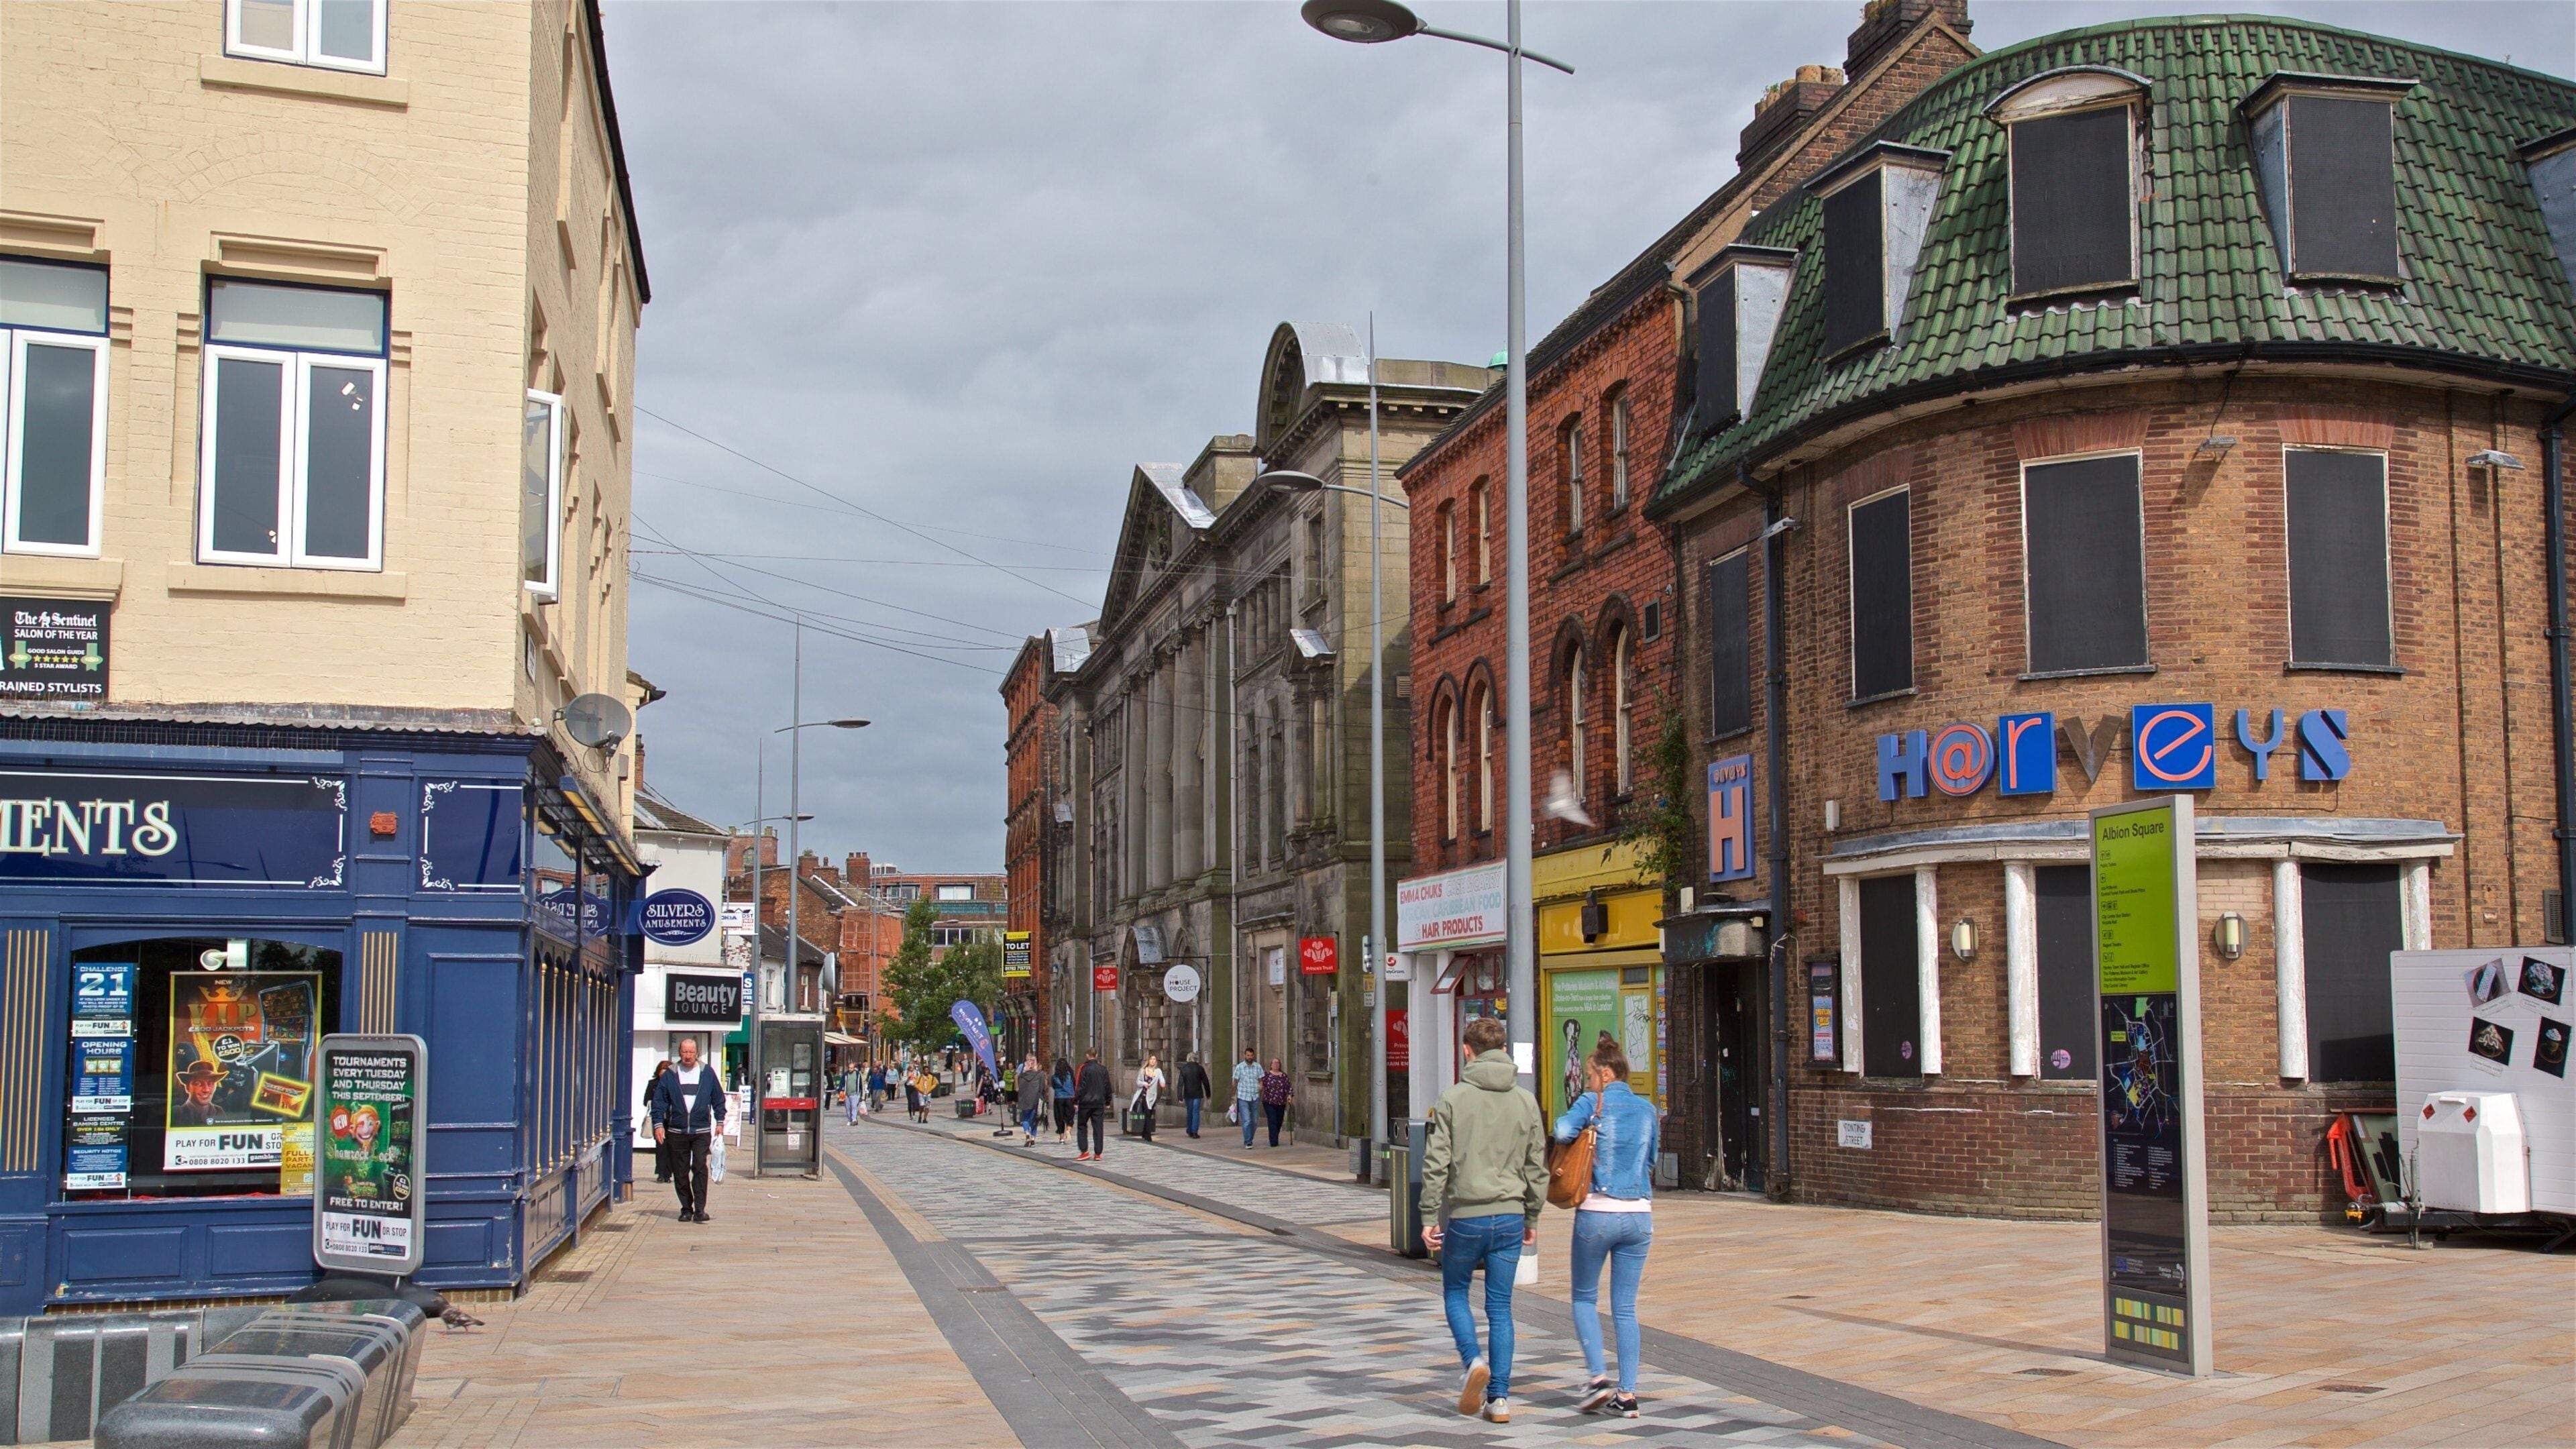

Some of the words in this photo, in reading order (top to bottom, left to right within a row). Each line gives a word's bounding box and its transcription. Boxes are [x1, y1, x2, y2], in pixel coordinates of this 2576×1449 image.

[15, 611, 38, 625] The
[52, 612, 97, 627] Sentinel
[15, 629, 43, 638] SALON
[45, 630, 56, 639] OF
[58, 631, 74, 639] THE
[76, 631, 98, 640] YEAR
[48, 683, 102, 693] STYLISTS
[1711, 786, 1745, 873] H
[2102, 825, 2129, 841] Albion
[2132, 822, 2164, 839] Square
[1400, 888, 1419, 904] EMMA
[1421, 883, 1442, 900] CHUKS
[647, 904, 705, 918] SILVERS
[1432, 897, 1475, 918] CARIBBEAN
[1477, 892, 1502, 911] FOOD
[645, 920, 706, 928] AMUSEMENTS
[1421, 922, 1440, 938] HAIR
[1442, 915, 1483, 936] PRODUCTS
[1016, 942, 1030, 950] LET
[79, 973, 127, 996] 21
[675, 981, 737, 1007] Beauty
[188, 1004, 258, 1024] VIP
[675, 1003, 727, 1014] LOUNGE
[218, 1049, 241, 1057] £500
[333, 1056, 407, 1067] TOURNAMENTS
[333, 1068, 363, 1077] EVERY
[365, 1069, 406, 1079] TUESDAY
[333, 1079, 353, 1089] AND
[354, 1079, 406, 1091] THURSDAY
[331, 1091, 351, 1099] THIS
[352, 1092, 405, 1102] SEPTEMBER!
[333, 1114, 348, 1130] NEW
[219, 1134, 263, 1150] FUN
[1845, 1135, 1863, 1145] STREET
[329, 1196, 353, 1207] FREE
[355, 1198, 368, 1208] TO
[370, 1200, 404, 1212] ENTER!
[325, 1221, 338, 1231] PLAY
[340, 1222, 350, 1232] FOR
[352, 1218, 382, 1239] FUN
[382, 1226, 390, 1236] OR
[391, 1227, 407, 1237] STOP
[332, 1243, 345, 1251] 0808
[345, 1244, 358, 1252] 8020
[358, 1244, 368, 1253] 133
